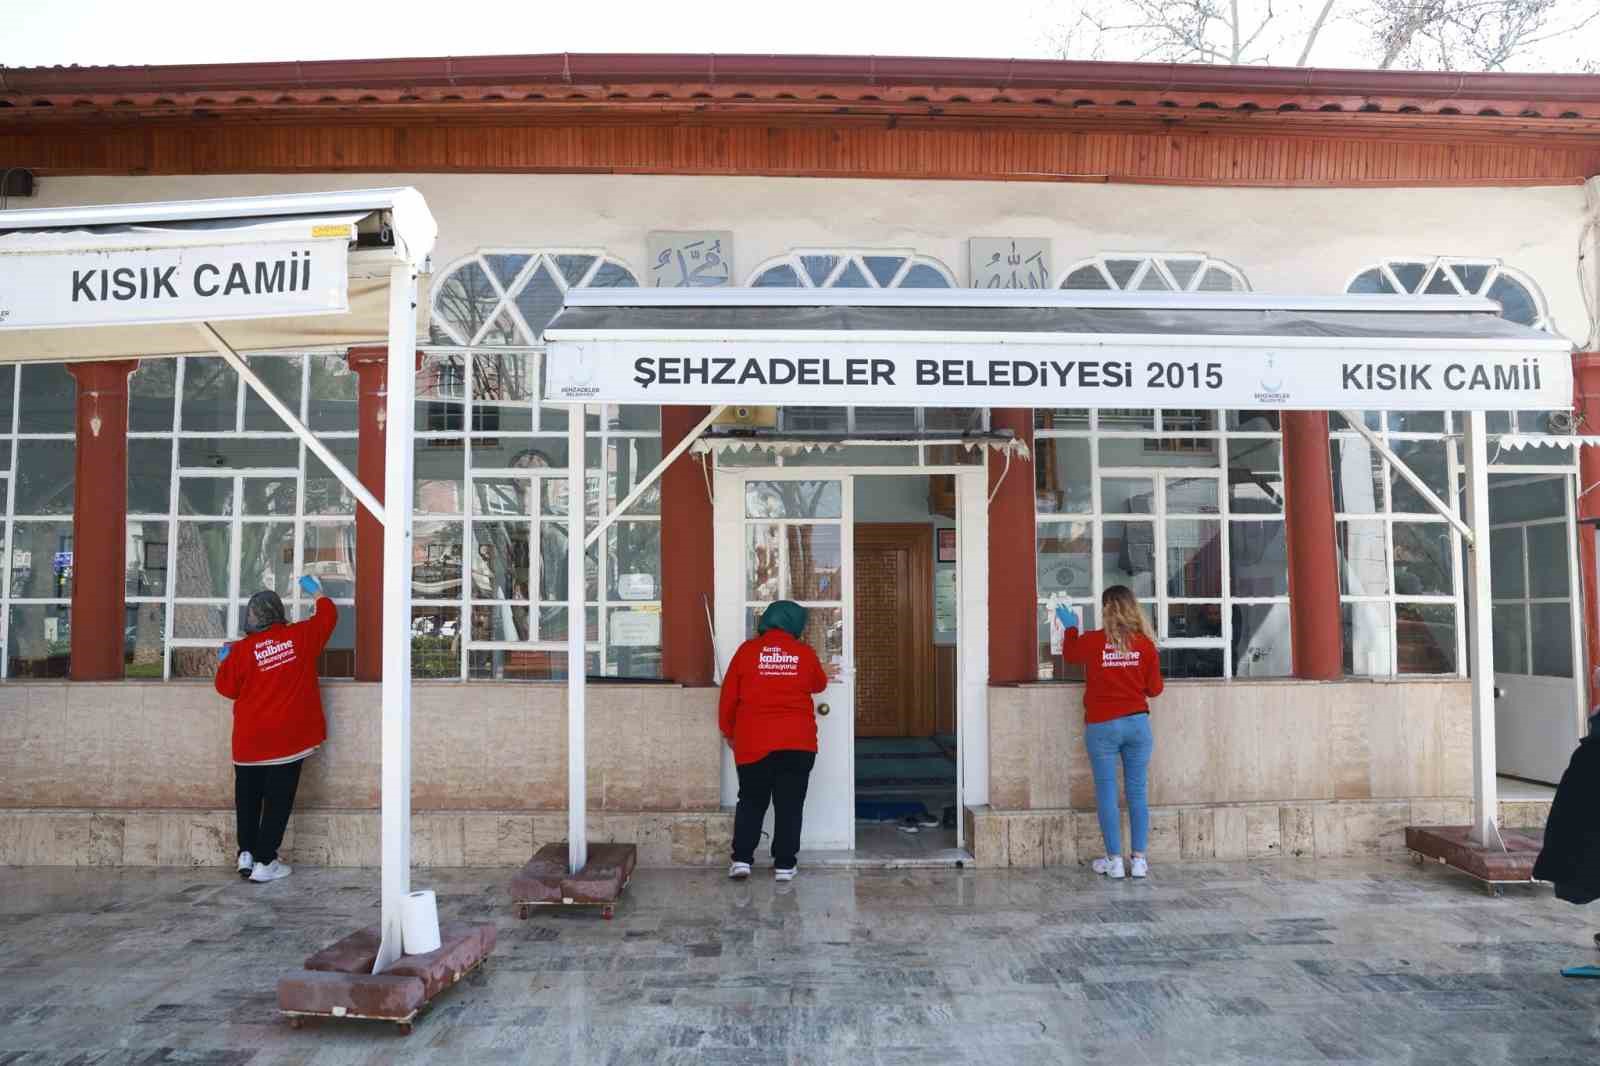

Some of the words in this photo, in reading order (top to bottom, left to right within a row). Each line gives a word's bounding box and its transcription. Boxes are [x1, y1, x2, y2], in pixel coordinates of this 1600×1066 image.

[71, 265, 179, 302] KISIK
[633, 357, 897, 389] ŞEHZADELER
[1146, 361, 1223, 389] 2015
[1342, 363, 1433, 391] KISIK
[254, 640, 295, 660] kalbine
[760, 652, 799, 664] kalbine
